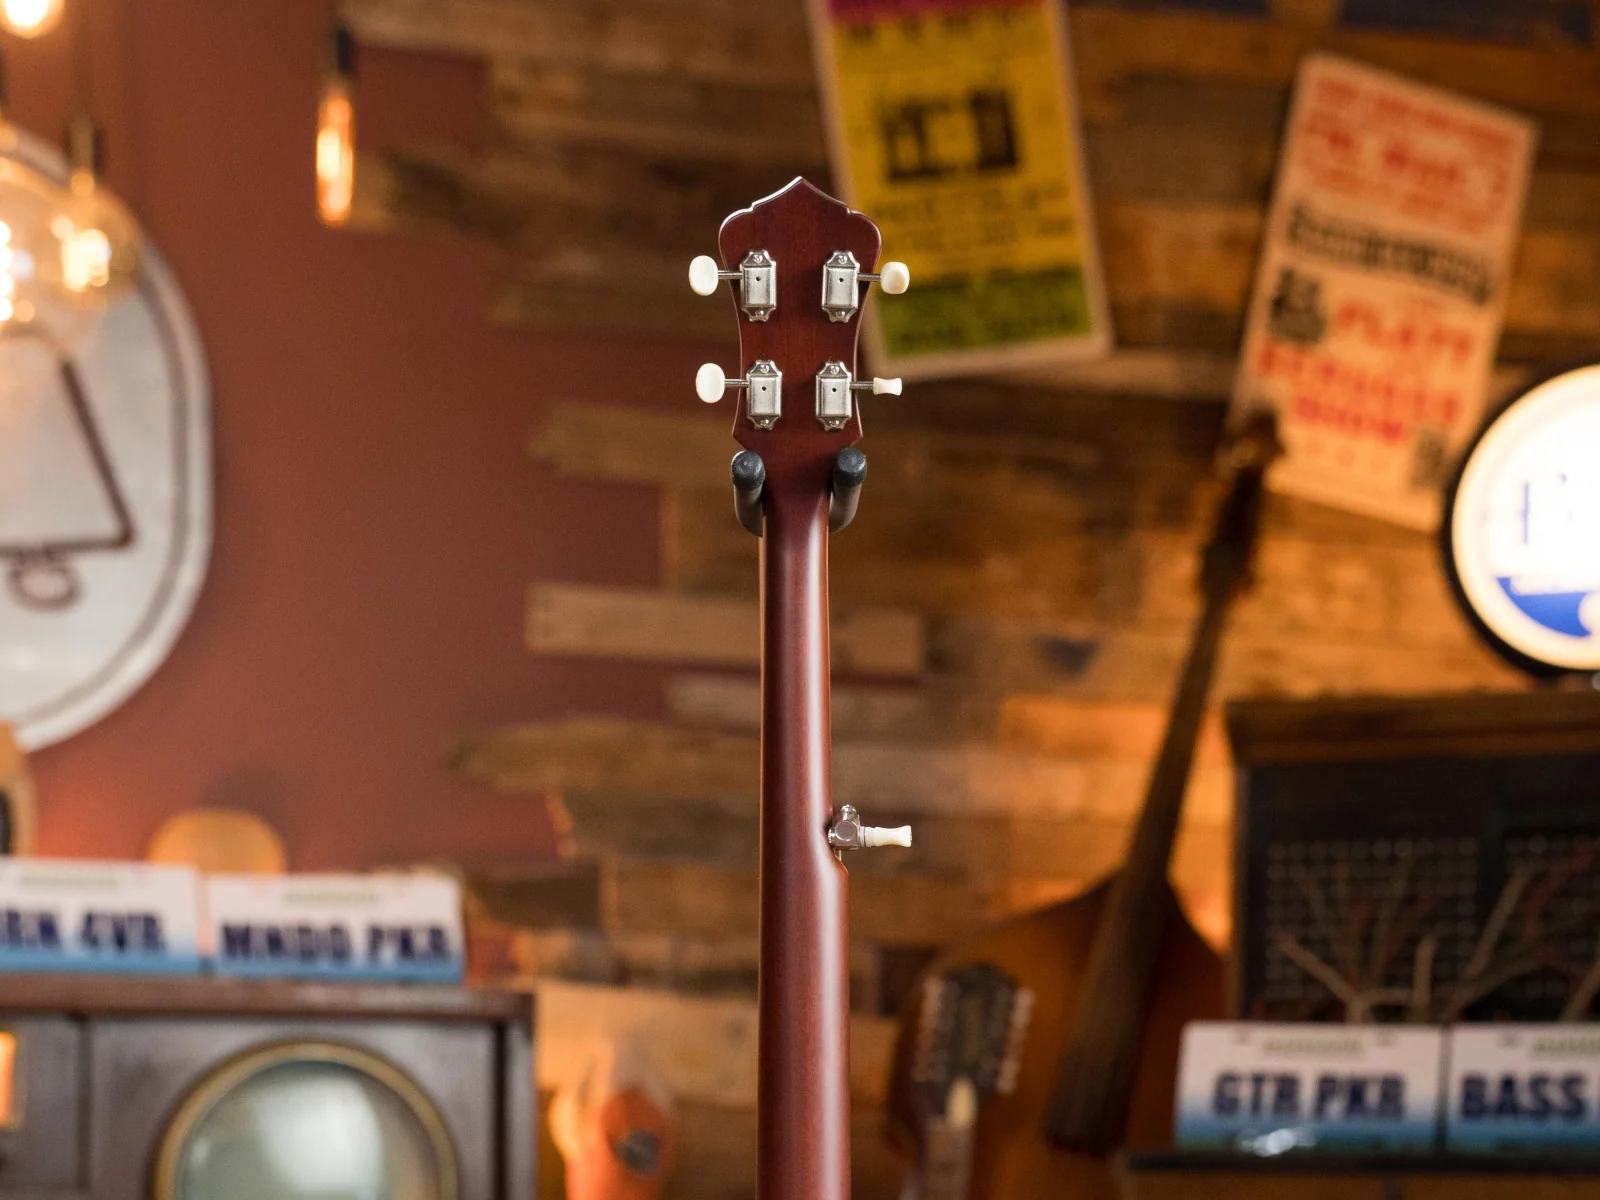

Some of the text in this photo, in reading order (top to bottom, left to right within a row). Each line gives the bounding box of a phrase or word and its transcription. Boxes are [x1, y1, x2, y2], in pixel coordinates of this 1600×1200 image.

[1213, 1073, 1405, 1117] GTR PKR
[1461, 1073, 1588, 1119] BASS
